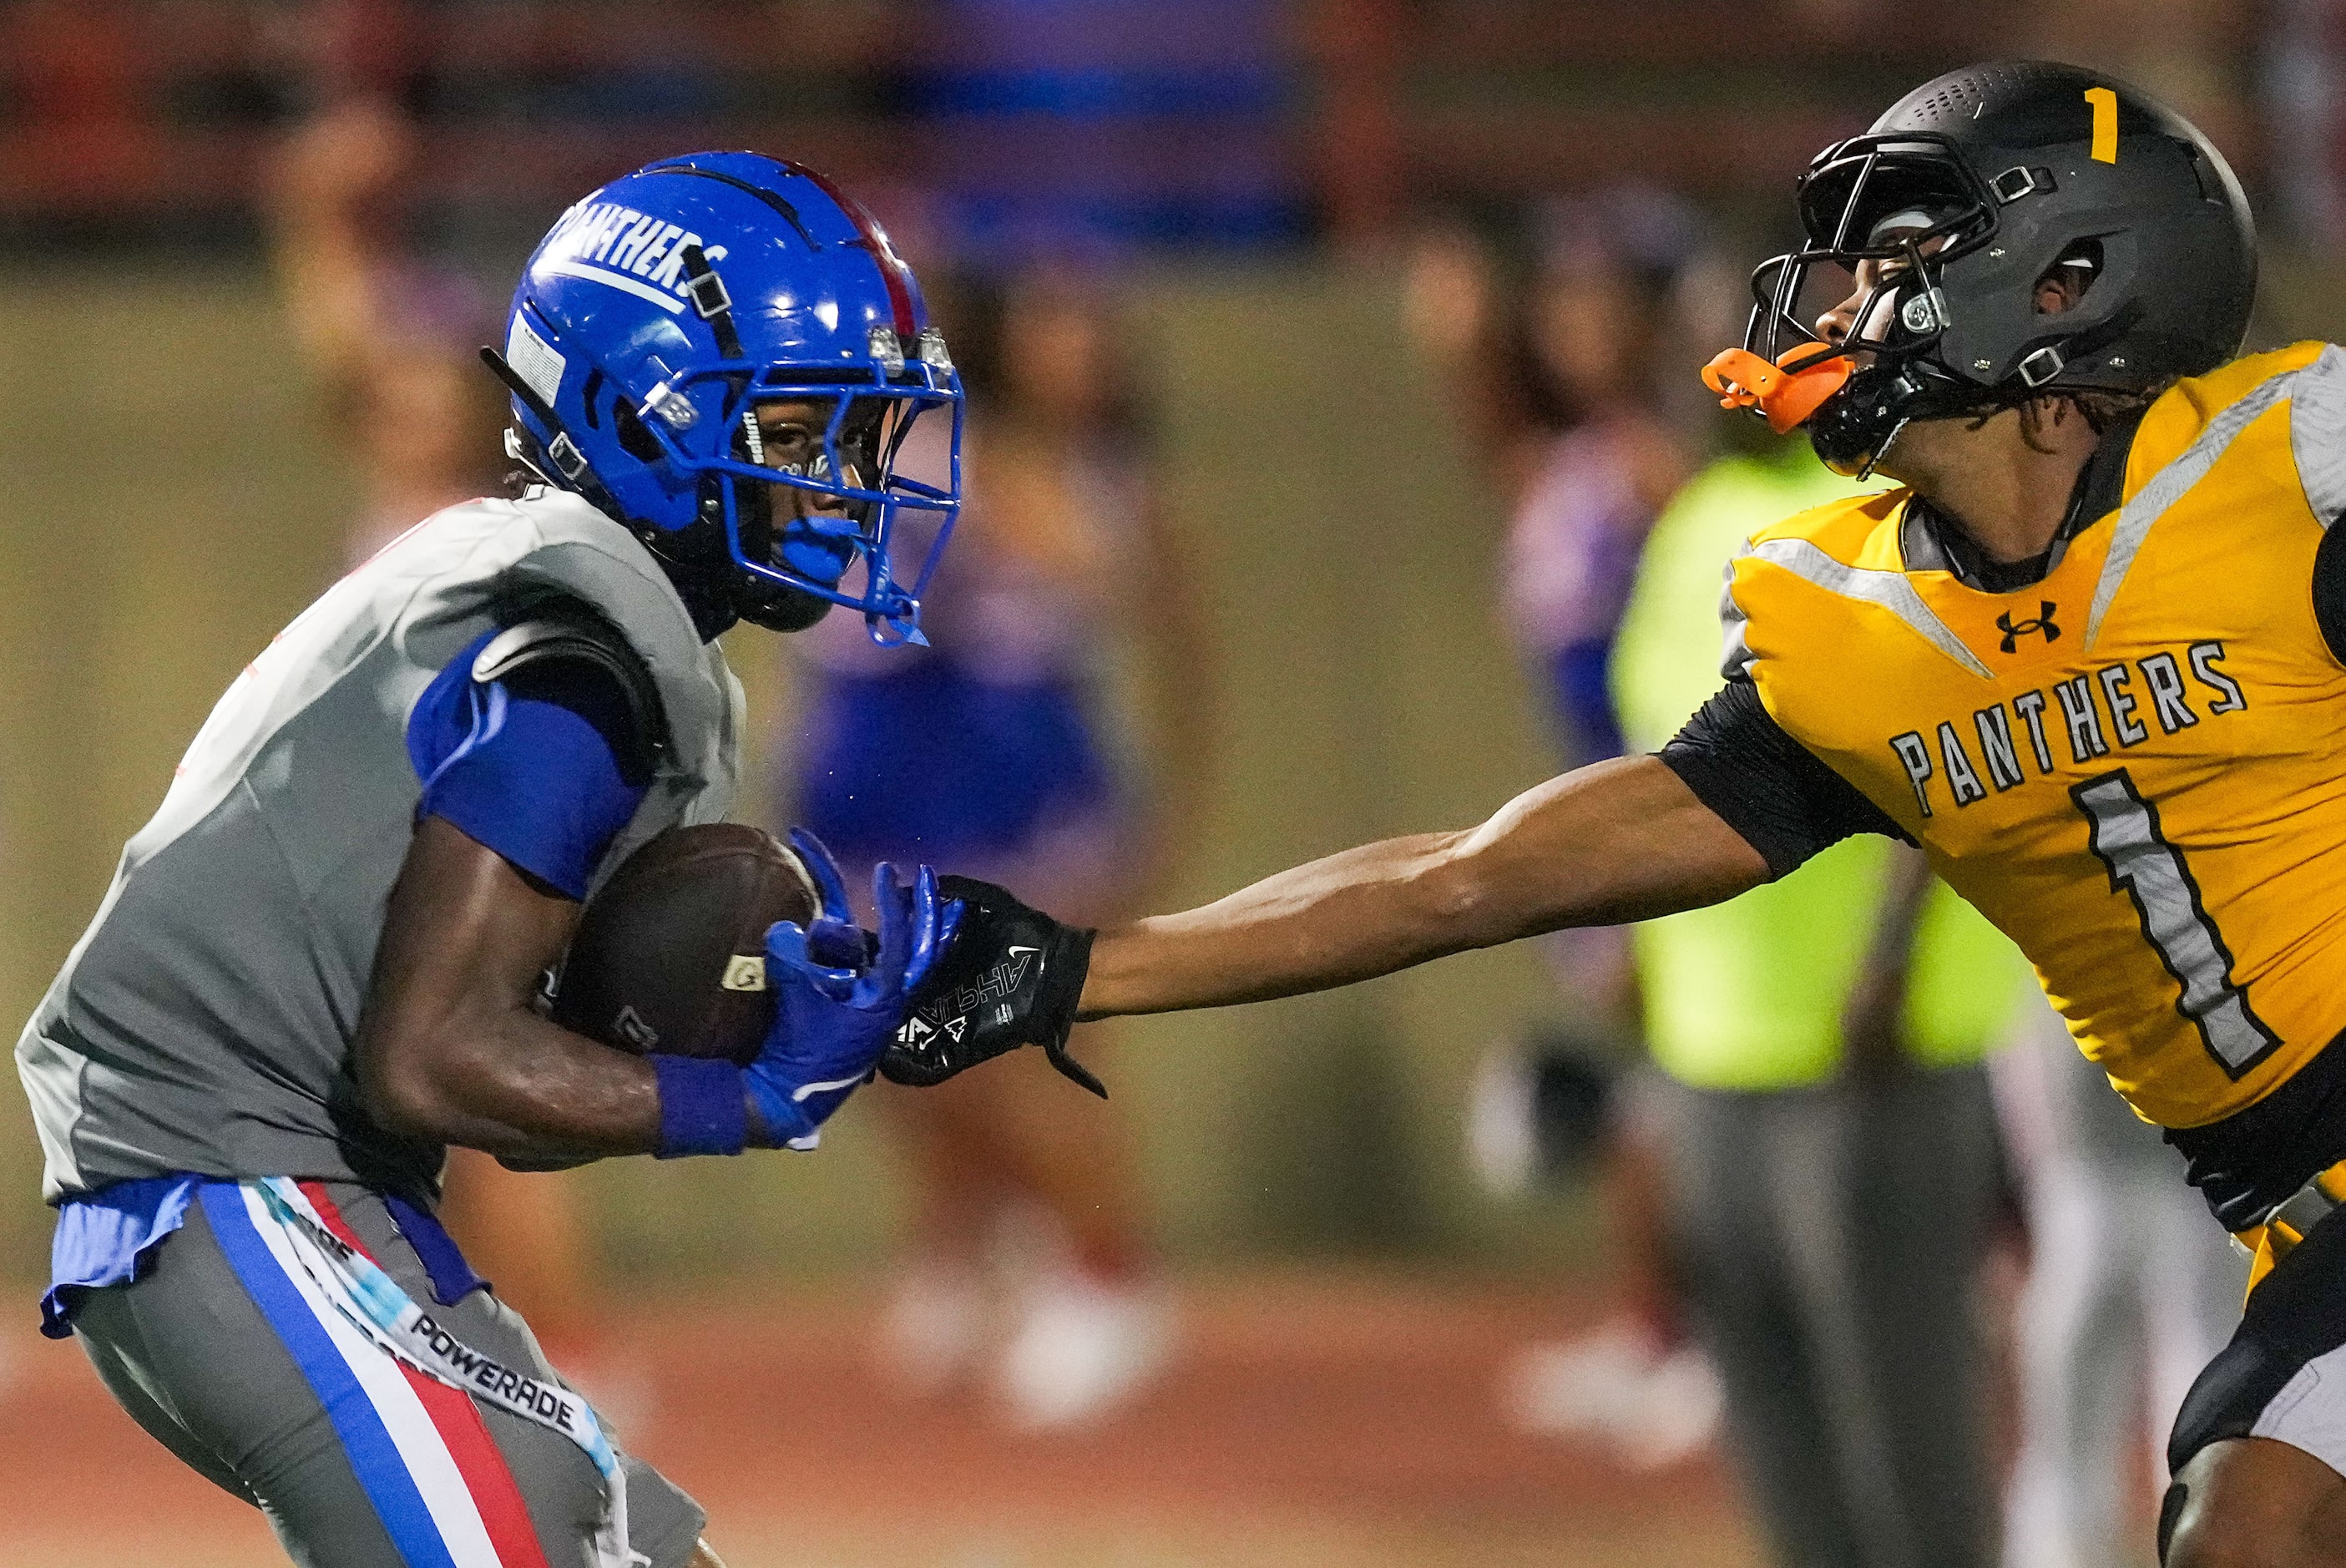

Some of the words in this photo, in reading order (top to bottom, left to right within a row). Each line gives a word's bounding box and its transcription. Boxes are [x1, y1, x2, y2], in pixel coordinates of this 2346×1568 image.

[2084, 87, 2119, 164] 1
[1888, 640, 2247, 817] PANTHERS
[2067, 766, 2286, 1082] 1
[411, 1314, 574, 1433] POWERADE
